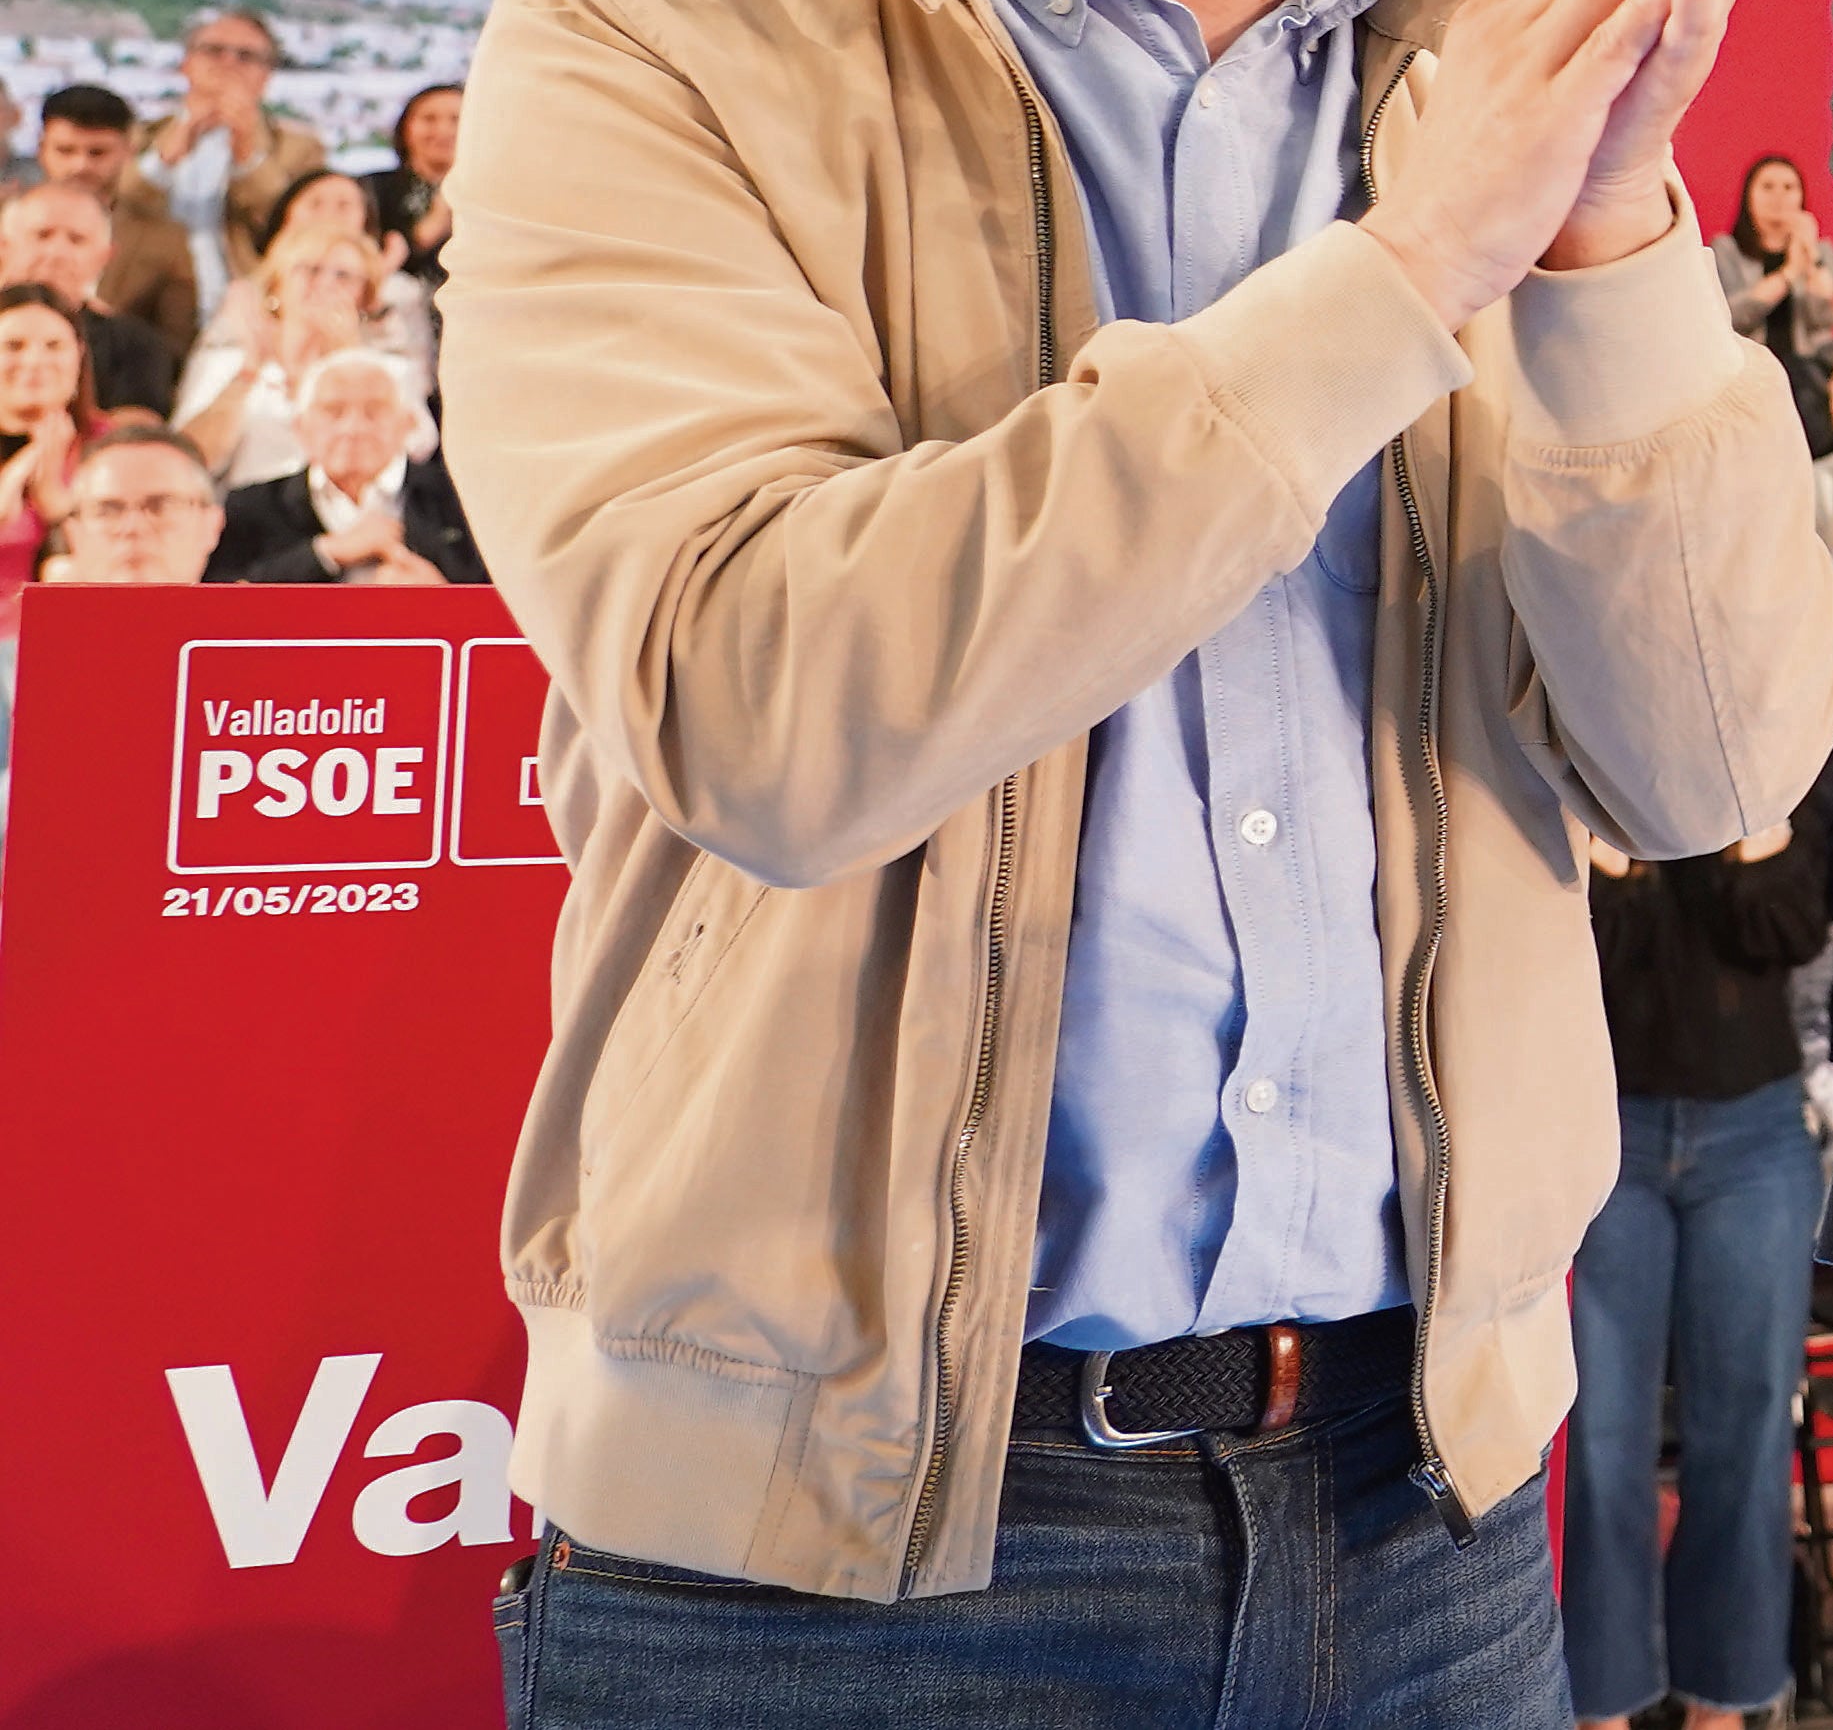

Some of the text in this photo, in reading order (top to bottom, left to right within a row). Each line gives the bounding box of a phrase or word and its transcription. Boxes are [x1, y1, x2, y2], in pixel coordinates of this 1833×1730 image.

[203, 698, 386, 737] Valladolid
[196, 747, 424, 819] PSOE
[162, 882, 420, 918] 21/05/2023
